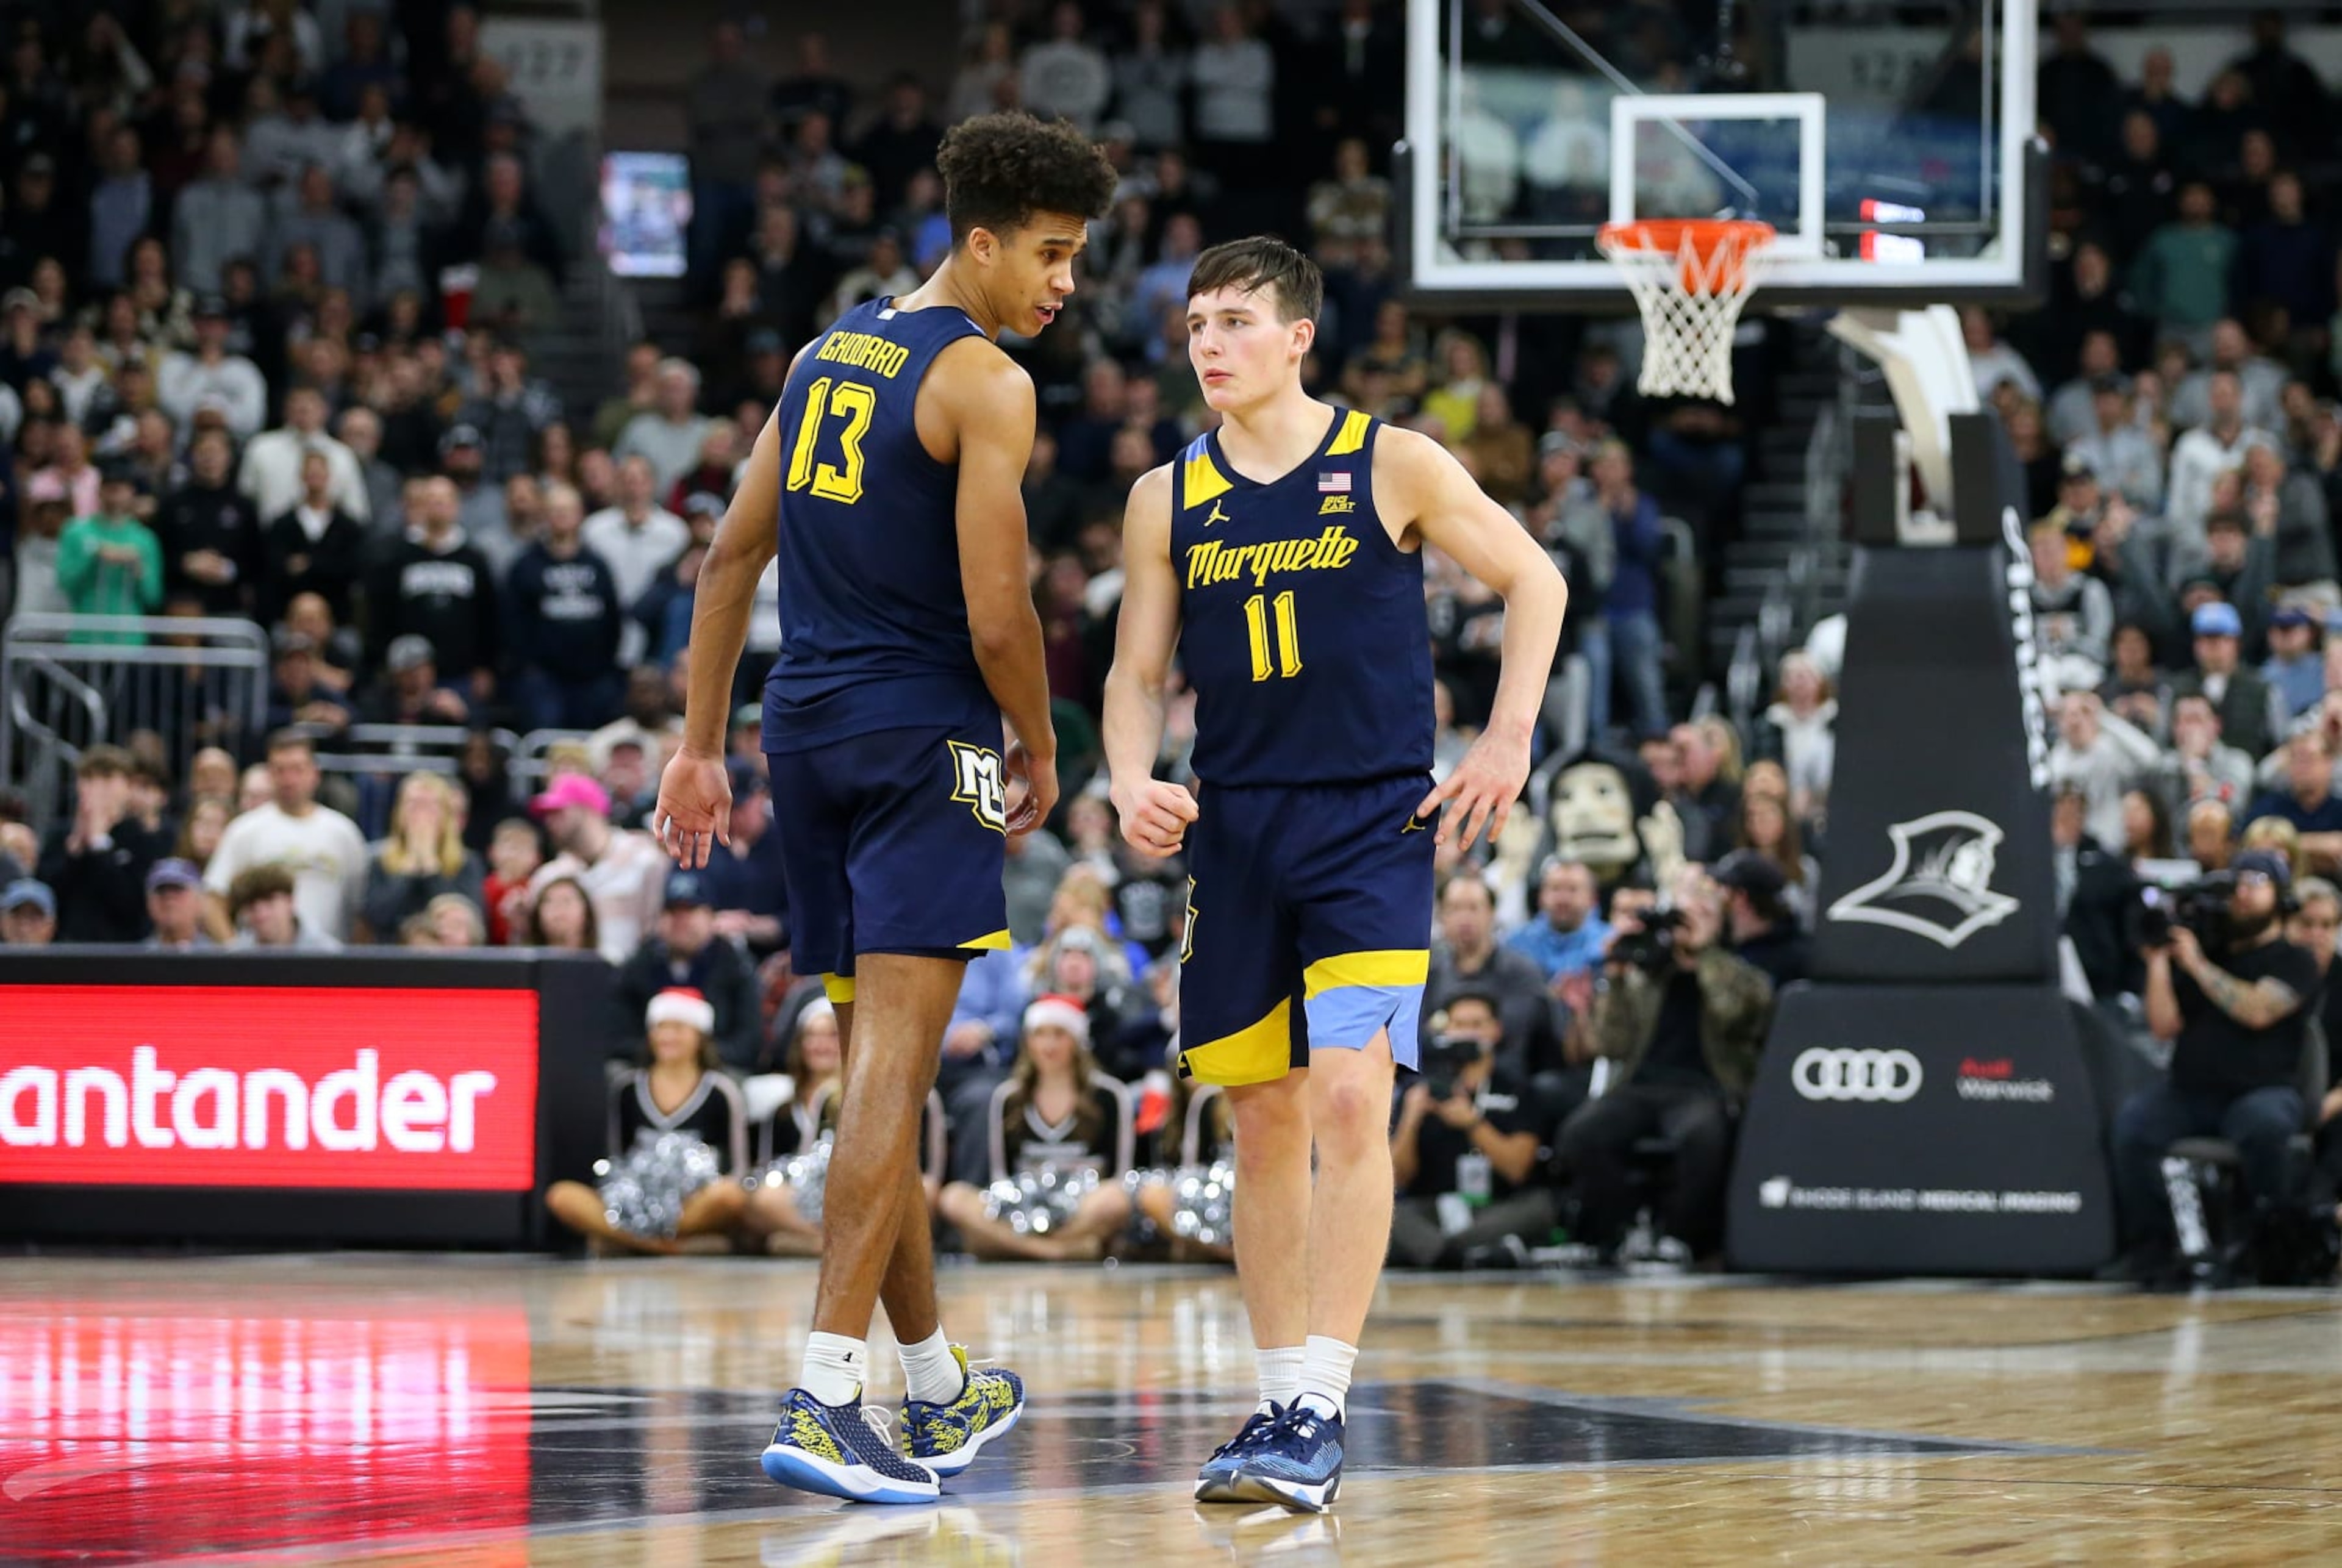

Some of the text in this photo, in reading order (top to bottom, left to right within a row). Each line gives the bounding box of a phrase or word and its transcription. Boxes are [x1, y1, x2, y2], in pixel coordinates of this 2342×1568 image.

[815, 331, 909, 379] IGHODARO
[787, 376, 876, 504] 13
[1320, 501, 1356, 512] EAST
[1323, 495, 1349, 504] BIG
[1186, 526, 1359, 589] Marquette
[1244, 590, 1303, 682] 11
[954, 745, 1006, 831] MU
[1955, 1076, 2054, 1103] Warwick
[1959, 1057, 2014, 1078] Audi
